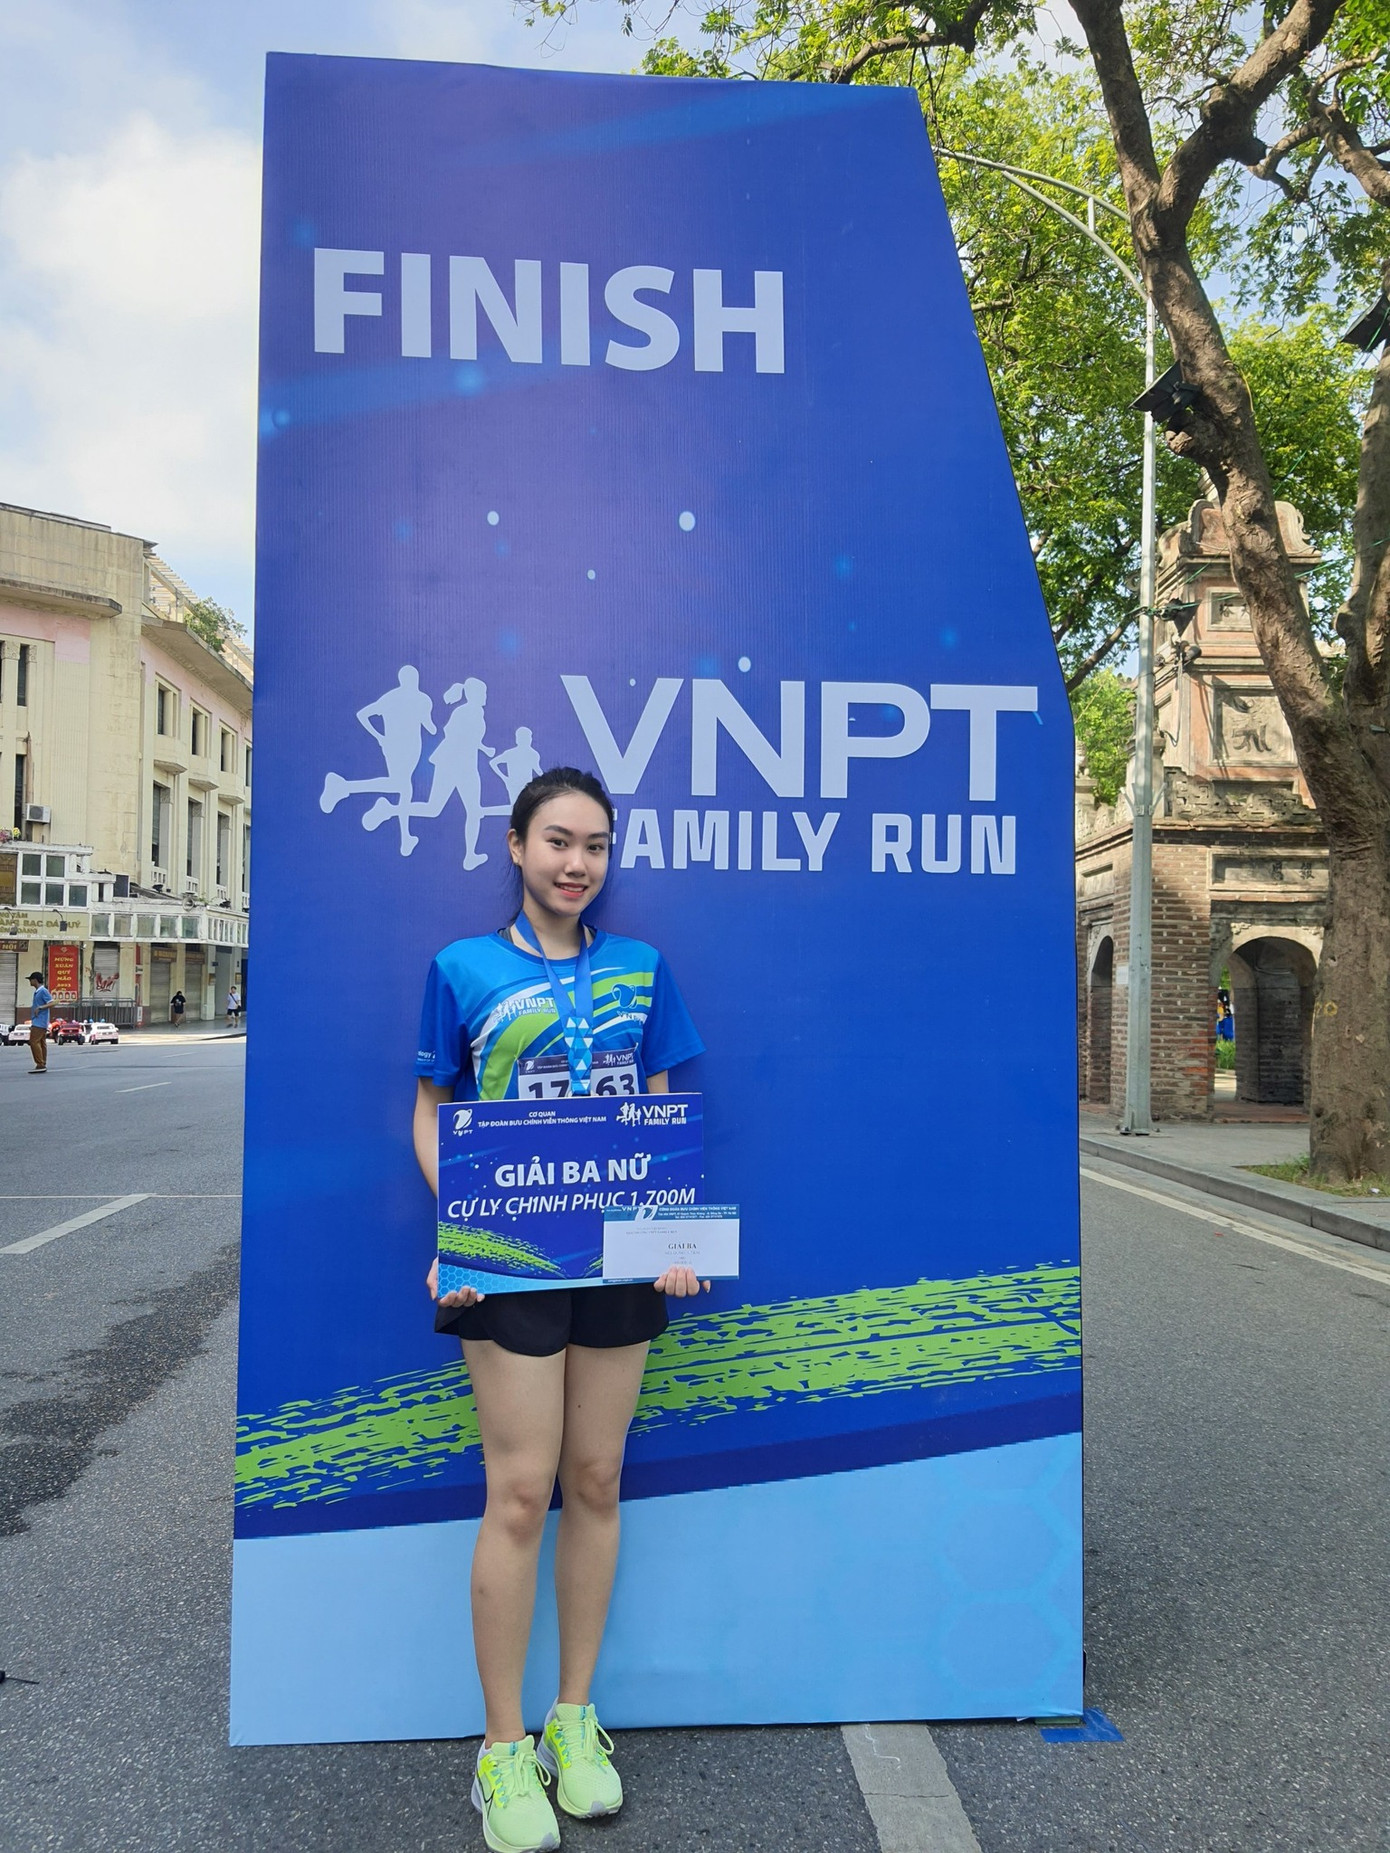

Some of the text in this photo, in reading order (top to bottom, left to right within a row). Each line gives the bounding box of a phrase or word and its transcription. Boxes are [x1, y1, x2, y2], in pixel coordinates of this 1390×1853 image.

[314, 248, 785, 373] FINISH
[560, 674, 1039, 801] VNPT
[612, 808, 1017, 876] AMILY RUN
[515, 997, 554, 1010] VNPT
[490, 1119, 508, 1127] ĐOÀN
[523, 1118, 542, 1126] CHÍNH
[557, 1116, 578, 1124] THÔNG
[578, 1116, 592, 1124] VIỆT
[538, 1110, 556, 1118] QUAN
[642, 1104, 688, 1118] VNPT
[644, 1118, 669, 1126] FAMILY
[495, 1152, 651, 1187] GIẢI BA NỮ
[448, 1197, 479, 1222] CỰ
[480, 1198, 502, 1216] LY
[571, 1190, 625, 1213] PHỤC
[630, 1187, 695, 1206] 1.700M
